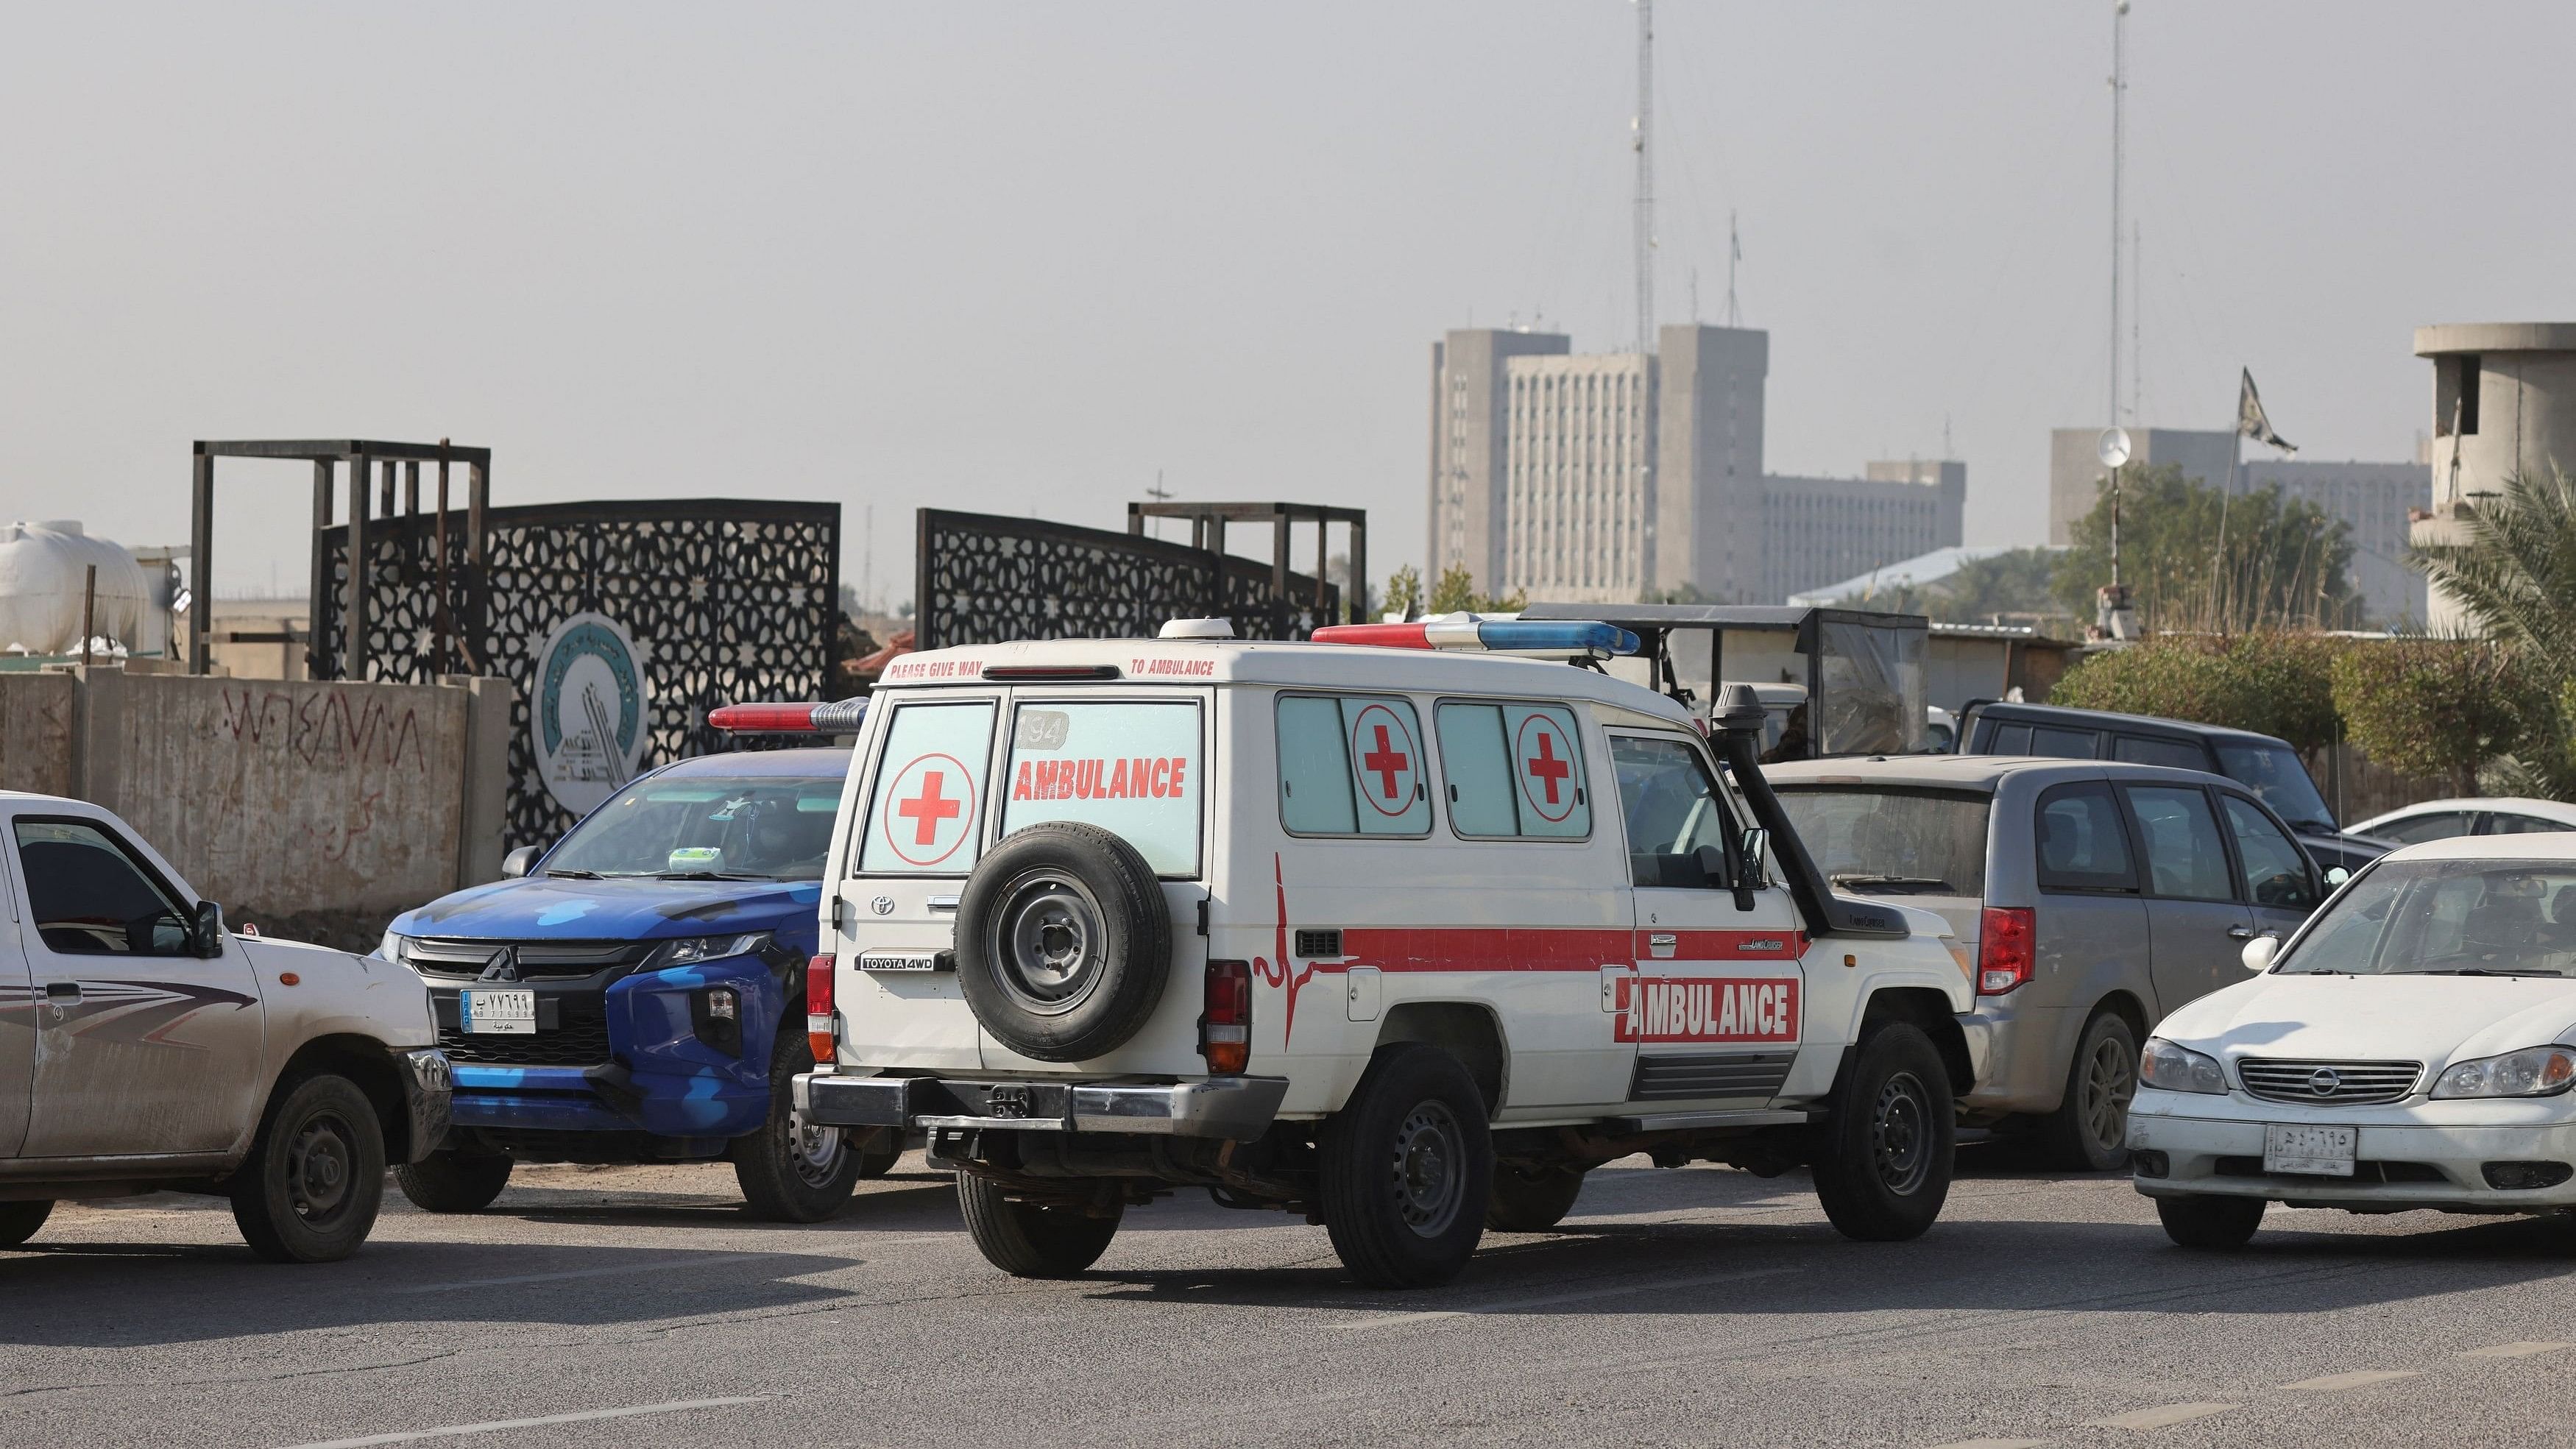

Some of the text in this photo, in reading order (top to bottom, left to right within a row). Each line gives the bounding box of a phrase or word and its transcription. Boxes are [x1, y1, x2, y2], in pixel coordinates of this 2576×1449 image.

[891, 659, 1214, 679] PLEASE GIVE WAY TO AMBULANCE
[1013, 757, 1186, 801] AMBULANCE
[865, 959, 932, 969] TOYOTA 4WD
[1624, 983, 1788, 1035] AMBULANCE
